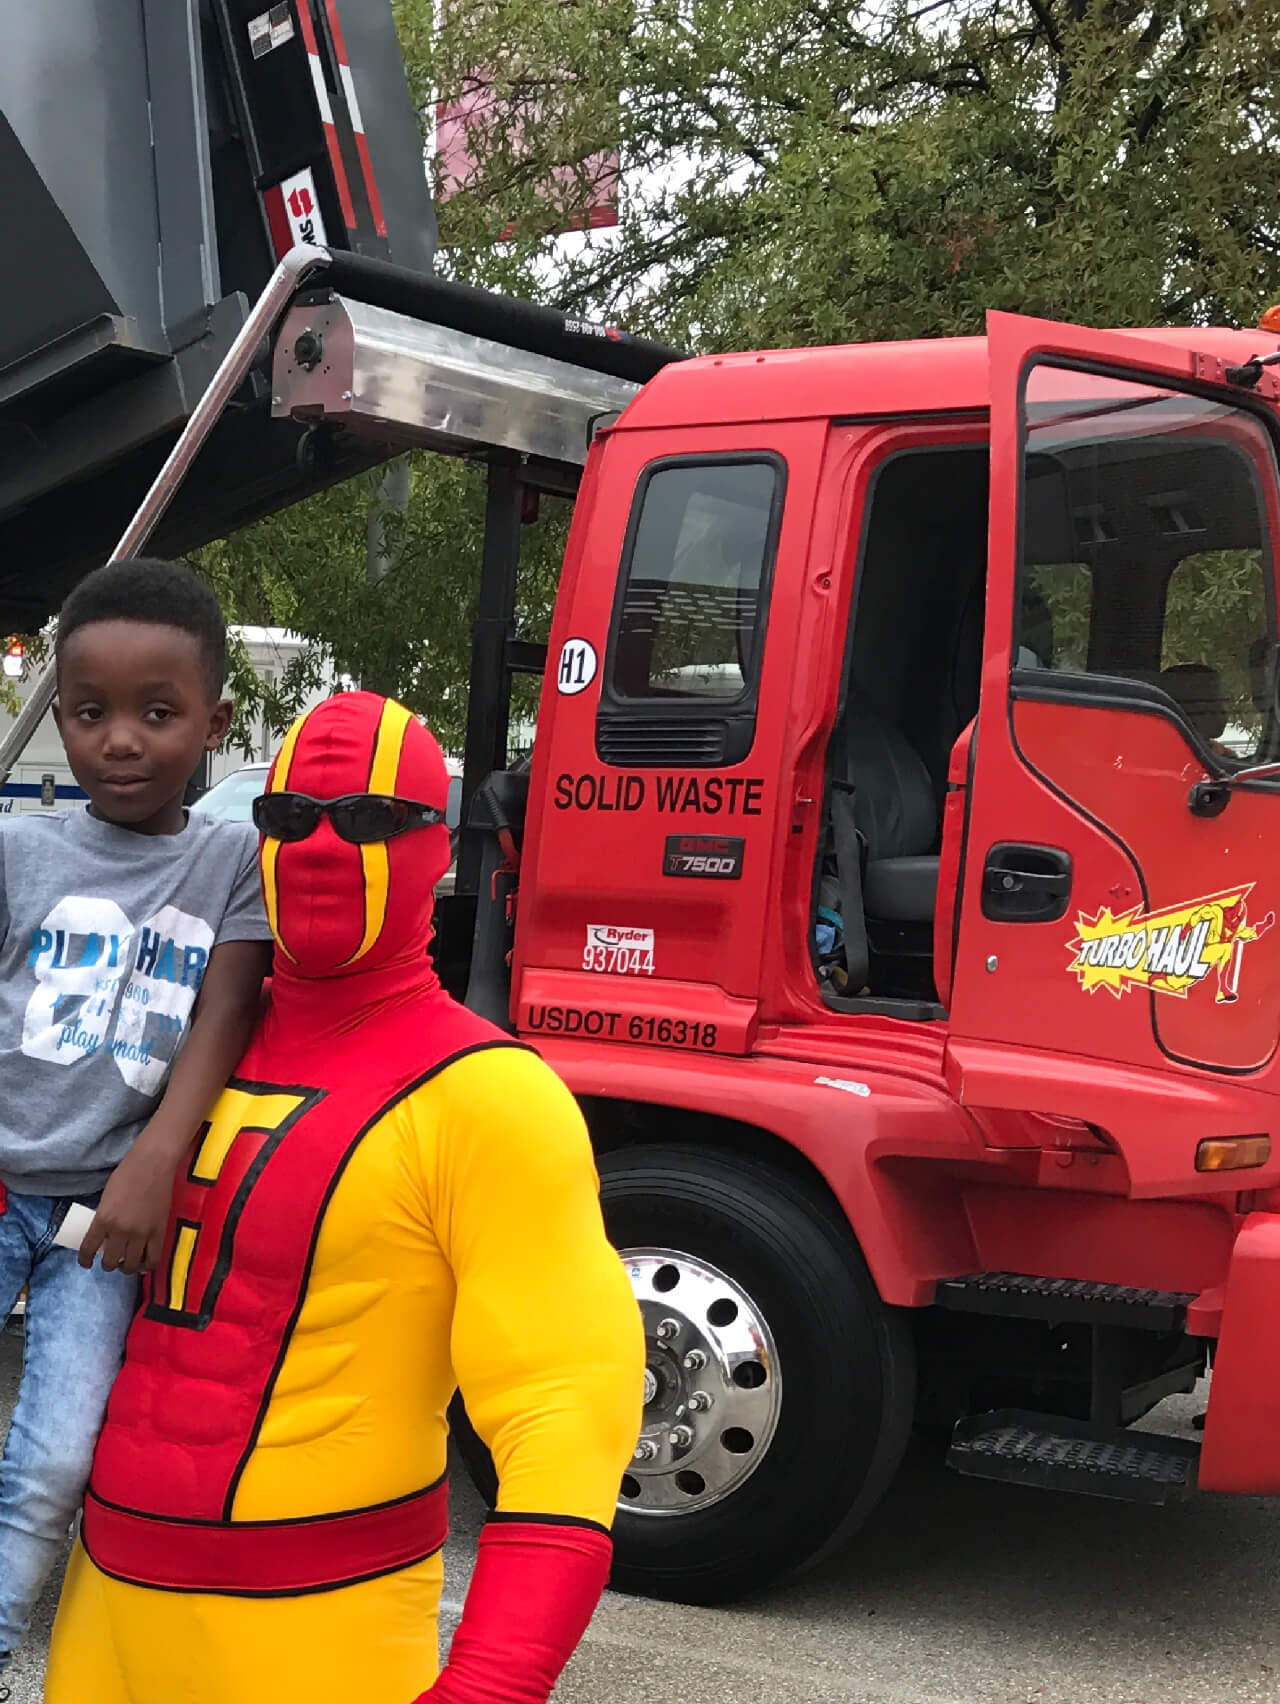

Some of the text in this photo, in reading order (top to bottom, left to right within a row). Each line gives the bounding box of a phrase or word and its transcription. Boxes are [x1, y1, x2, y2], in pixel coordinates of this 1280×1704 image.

[558, 648, 587, 684] H1
[554, 773, 765, 816] SOLID WASTE
[680, 839, 729, 853] GMC
[606, 928, 650, 942] Ryder
[1077, 920, 1213, 979] TURBO HAUL
[135, 926, 209, 989] HAR
[582, 945, 656, 976] 937044
[528, 1005, 717, 1048] USDOT 616318
